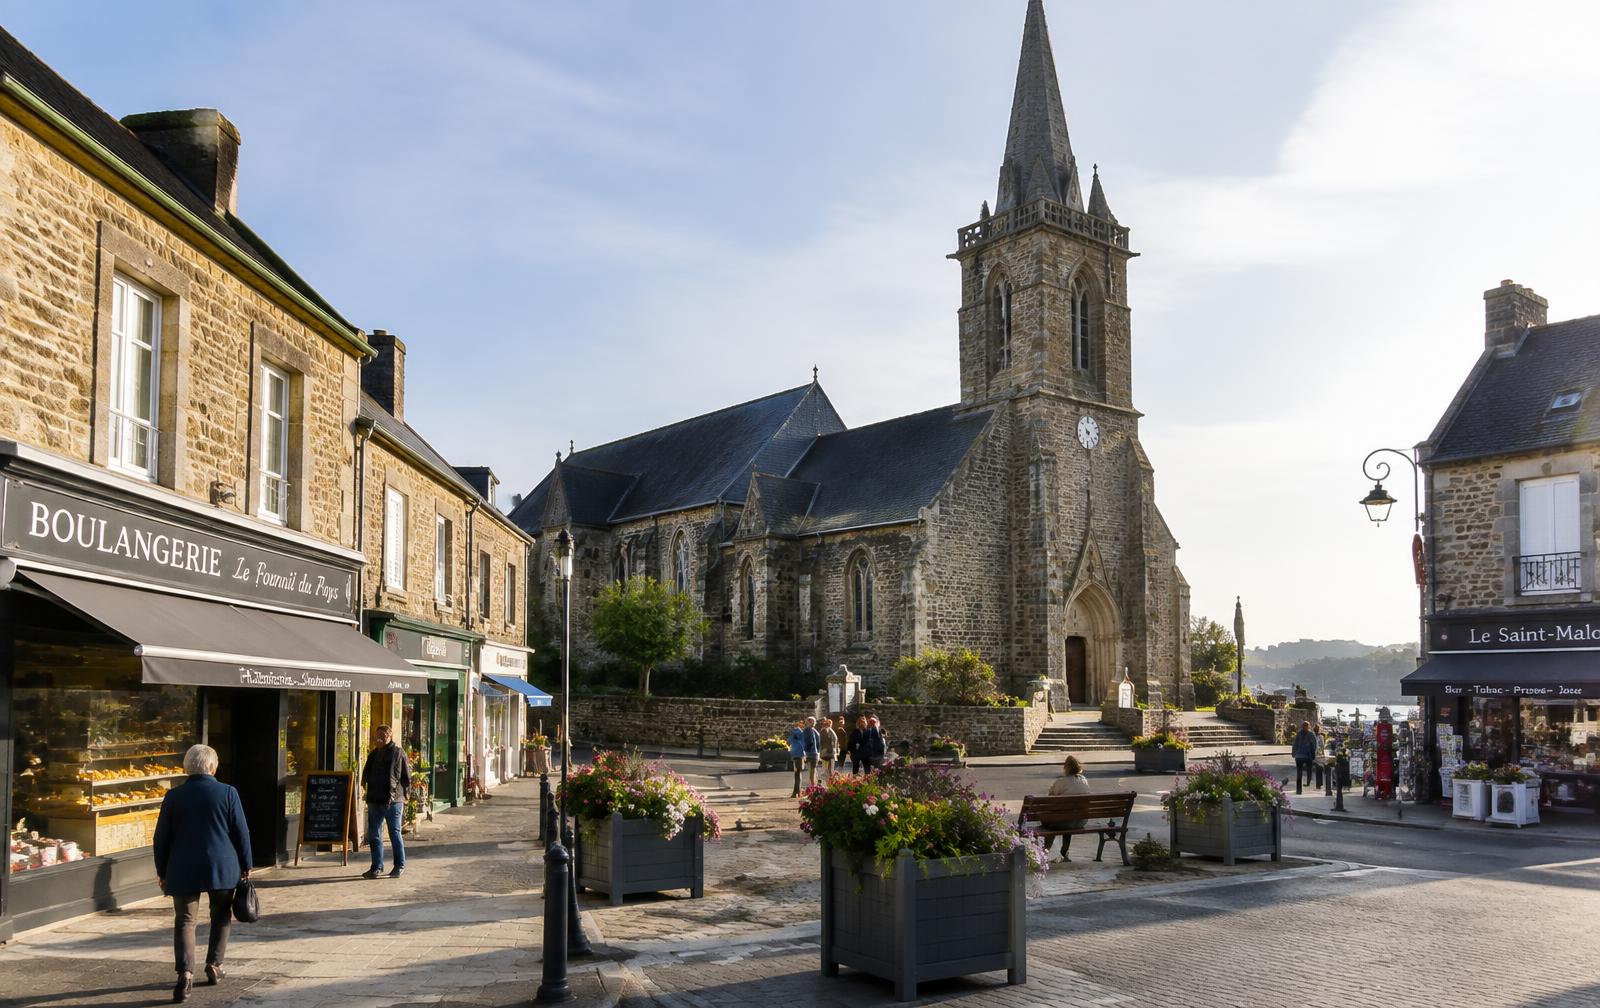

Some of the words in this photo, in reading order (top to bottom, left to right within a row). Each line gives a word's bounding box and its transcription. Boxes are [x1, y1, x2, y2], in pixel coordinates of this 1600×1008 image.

[28, 501, 222, 577] BOULANGERIE
[232, 557, 250, 581] Le
[298, 573, 312, 595] du
[1468, 628, 1491, 644] Le
[1498, 623, 1600, 643] Saint-Malo
